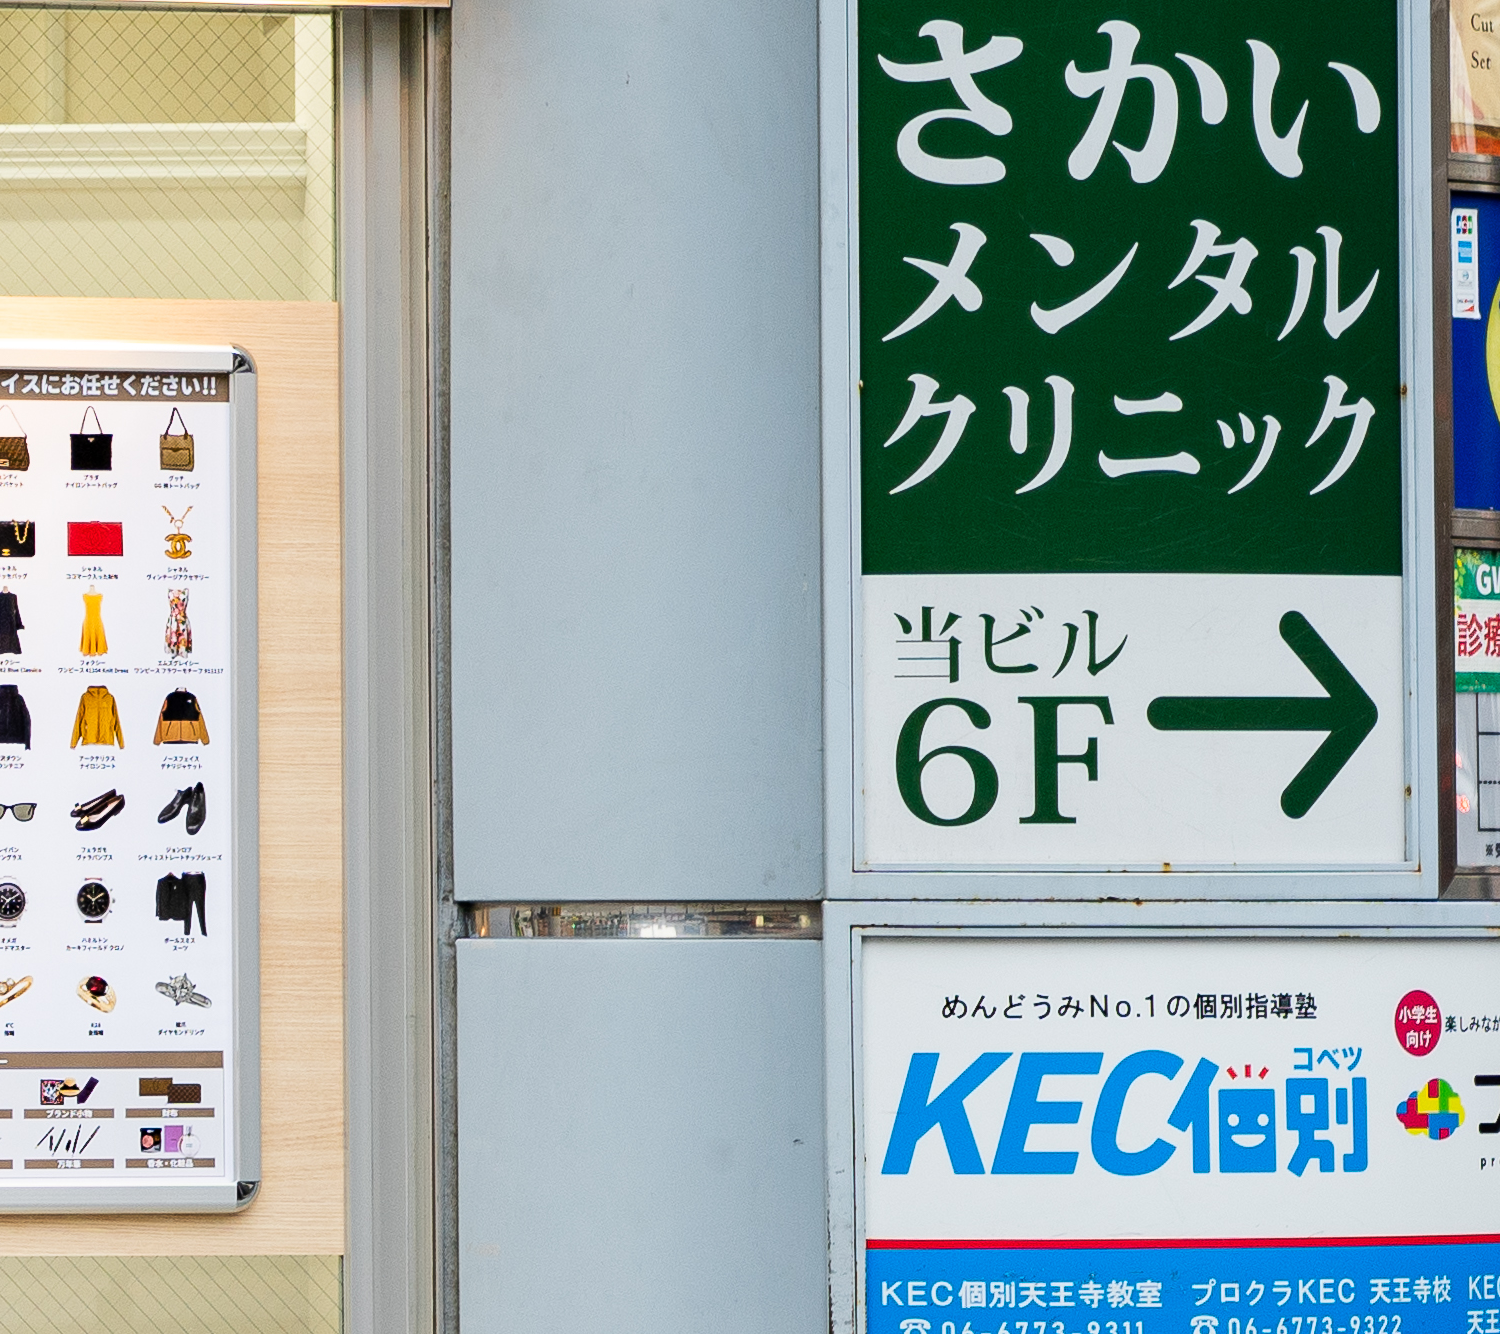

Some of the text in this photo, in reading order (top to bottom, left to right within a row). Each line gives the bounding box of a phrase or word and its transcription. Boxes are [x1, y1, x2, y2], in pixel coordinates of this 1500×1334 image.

[1470, 49, 1492, 71] Set
[877, 18, 1382, 185] さかい
[881, 218, 1380, 343] メンタル
[883, 373, 1376, 497] クリニック
[894, 603, 1128, 683] 当ビル
[894, 694, 1115, 827] 6F
[941, 992, 1318, 1022] めんどうみNo.1の個別指導塾
[1398, 1004, 1438, 1025] 小学生
[1405, 1029, 1432, 1049] 向け
[1293, 1044, 1364, 1073] コベツ
[1191, 1274, 1453, 1307] プロクラKEC 天王寺校
